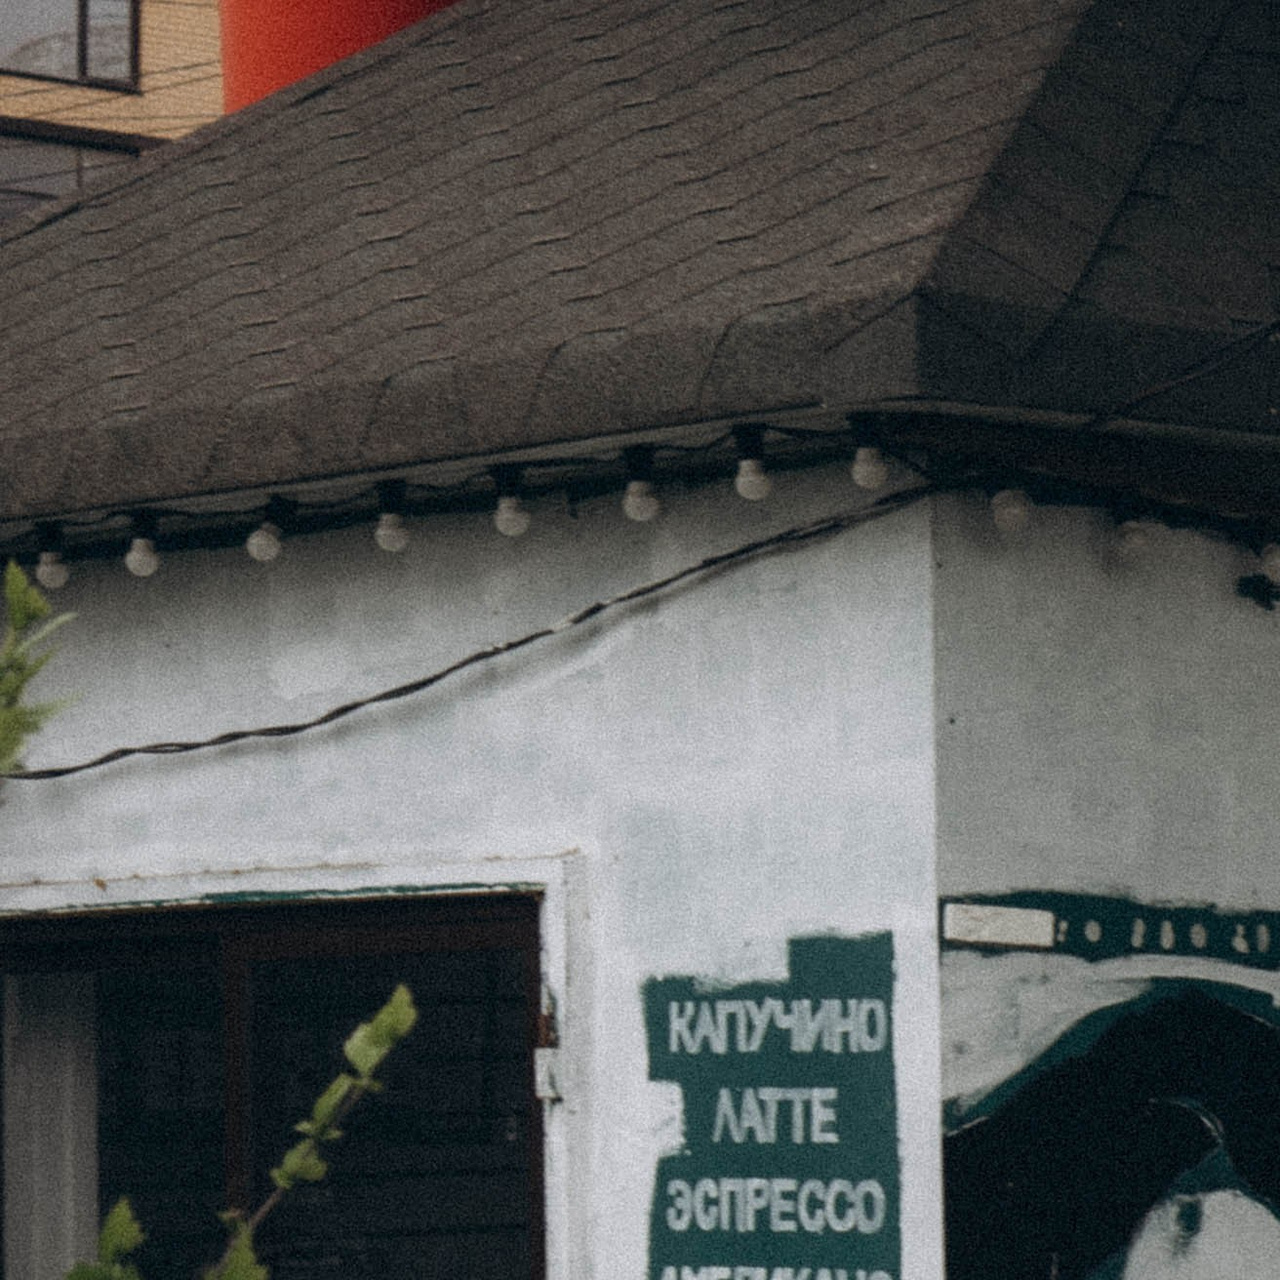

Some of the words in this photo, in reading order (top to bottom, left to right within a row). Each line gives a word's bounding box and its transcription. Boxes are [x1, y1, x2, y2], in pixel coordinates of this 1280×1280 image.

[670, 998, 887, 1054] КАПУЧИНО
[714, 1088, 839, 1144] ЛАТТЕ
[667, 1178, 885, 1233] ЭСПРЕССО
